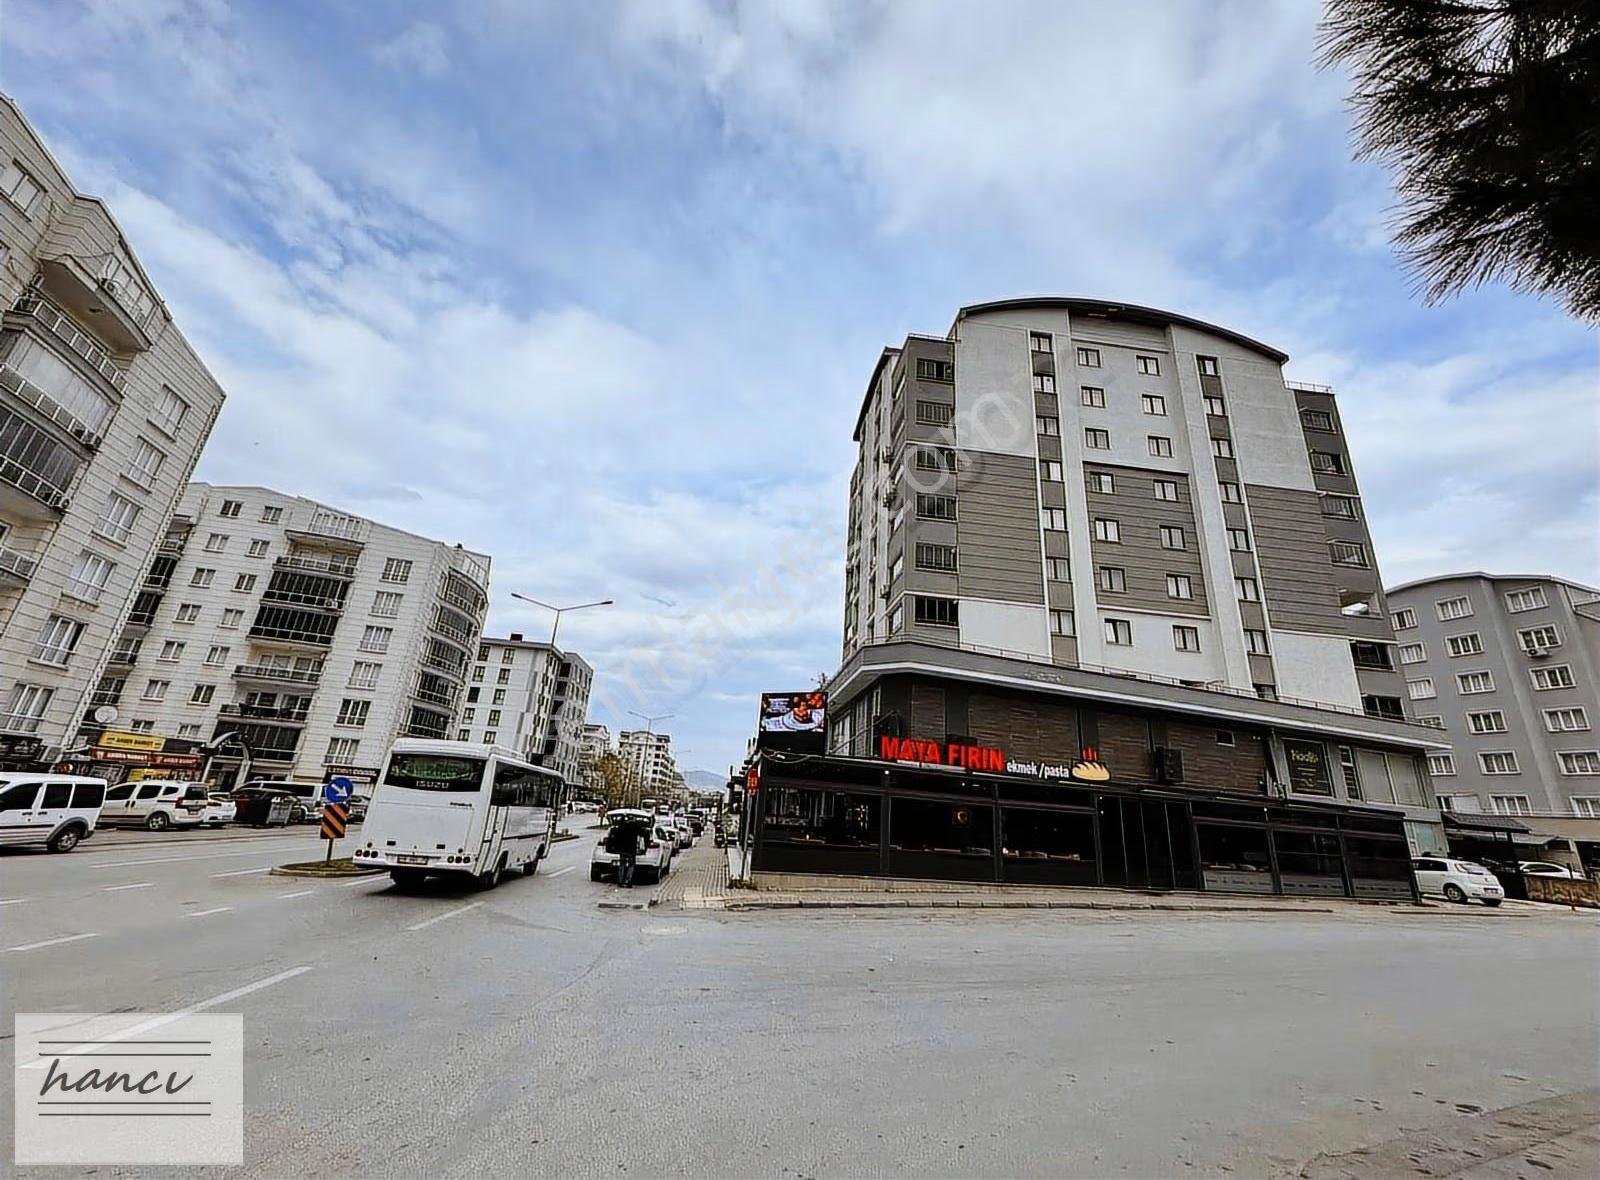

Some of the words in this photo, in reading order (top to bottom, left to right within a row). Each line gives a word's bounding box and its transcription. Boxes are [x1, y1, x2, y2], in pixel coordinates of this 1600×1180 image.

[880, 735, 941, 764] MAYA
[948, 744, 1006, 773] FIRIN
[1006, 760, 1038, 775] ekmek
[415, 780, 450, 789] ISUZU
